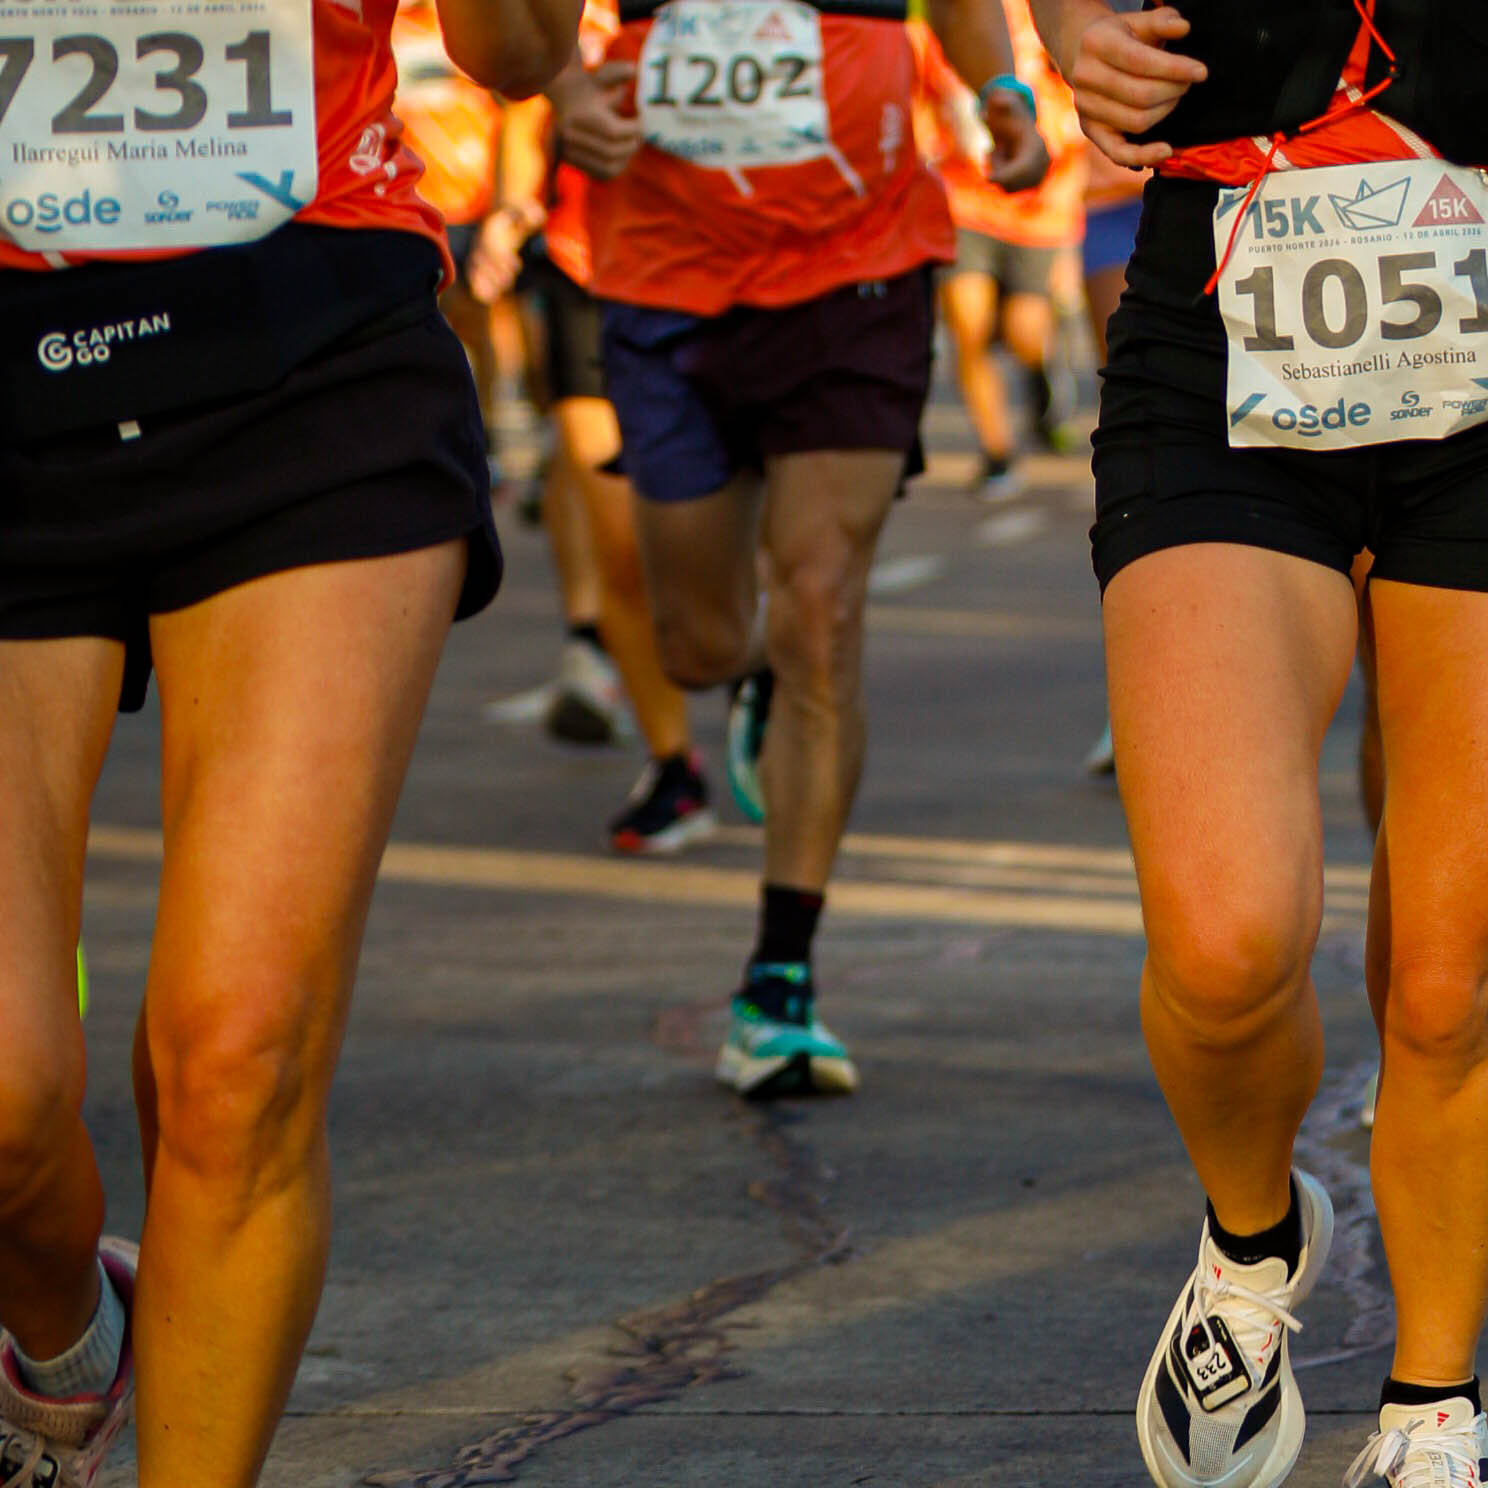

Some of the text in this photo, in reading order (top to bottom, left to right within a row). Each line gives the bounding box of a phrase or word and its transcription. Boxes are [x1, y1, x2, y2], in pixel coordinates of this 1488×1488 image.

[646, 50, 811, 107] 1202
[107, 139, 168, 160] Maria
[175, 136, 248, 158] Melina
[6, 188, 121, 232] osde
[1246, 195, 1325, 239] 15K
[1428, 197, 1468, 219] 15K
[1350, 234, 1393, 245] ROSARIO
[73, 312, 170, 347] CAPITAN
[76, 344, 110, 365] GO
[1281, 347, 1476, 381] Sebastianelli Agostina
[1272, 398, 1371, 436] osde
